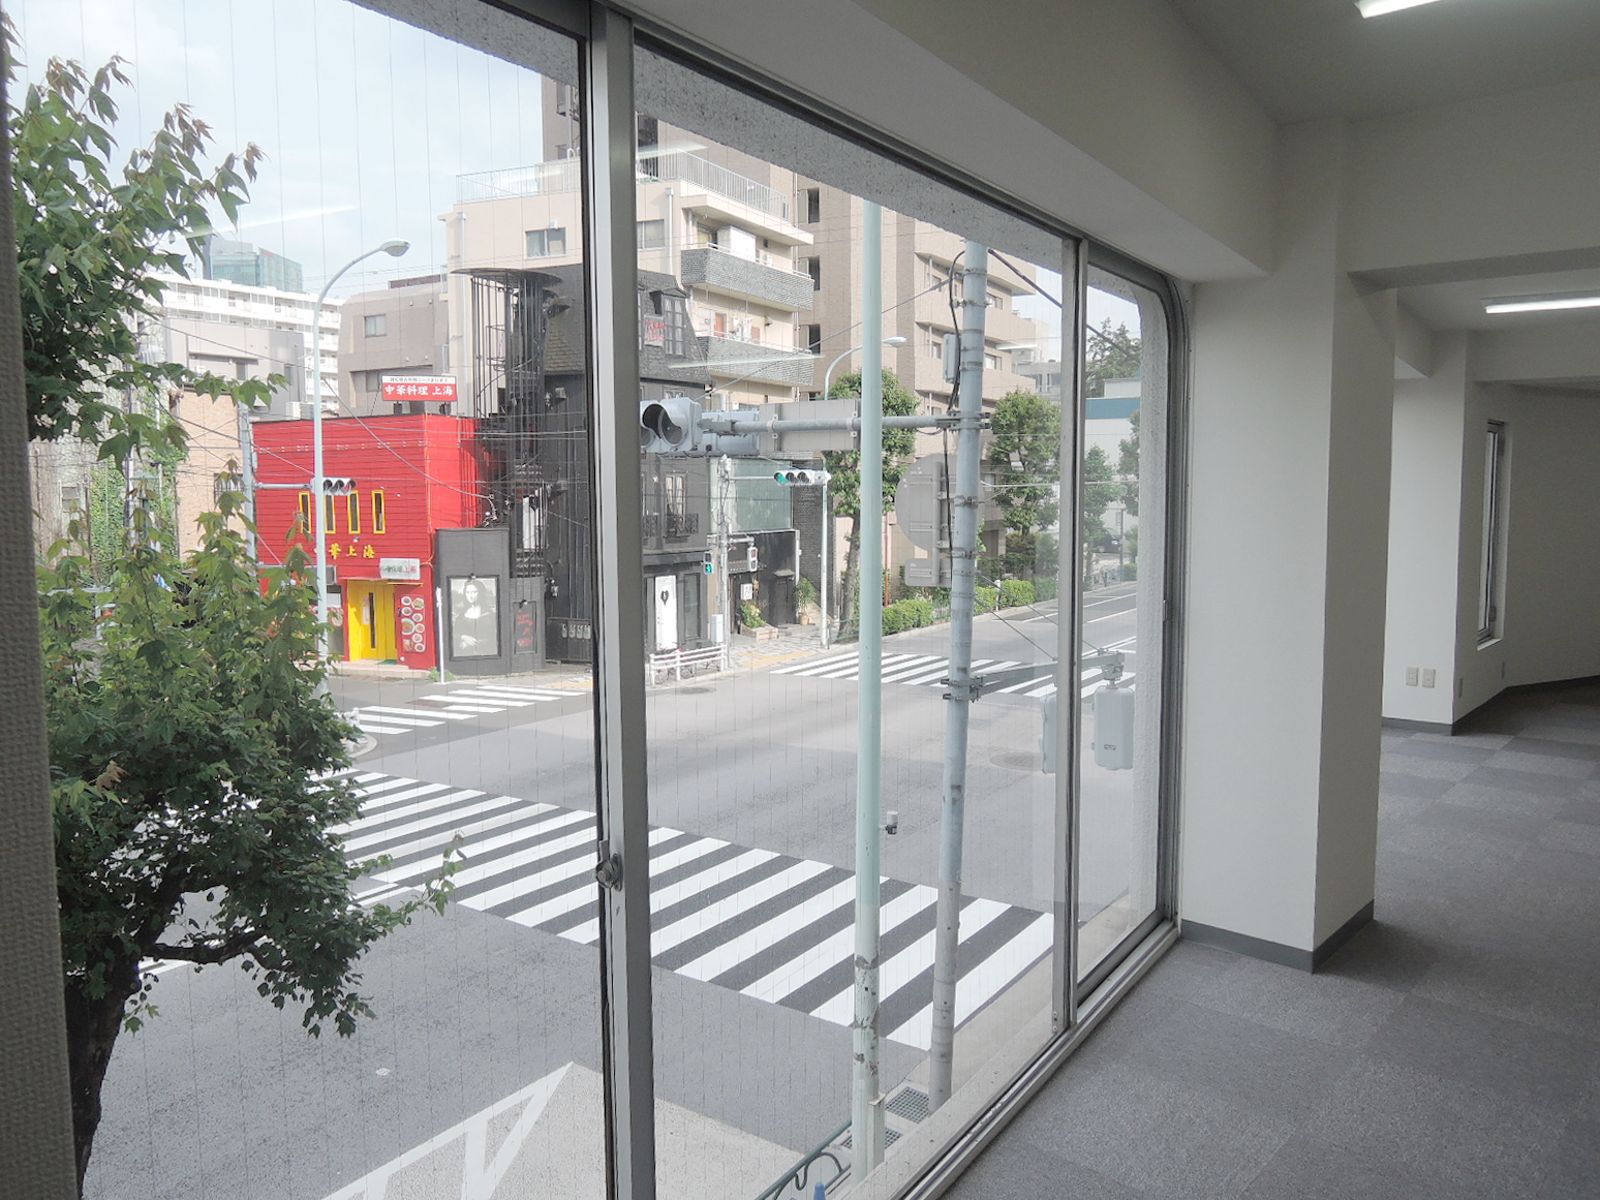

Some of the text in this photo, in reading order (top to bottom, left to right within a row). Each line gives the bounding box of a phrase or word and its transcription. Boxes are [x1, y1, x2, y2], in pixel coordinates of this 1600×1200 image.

[384, 384, 453, 396] 中華料理 上海
